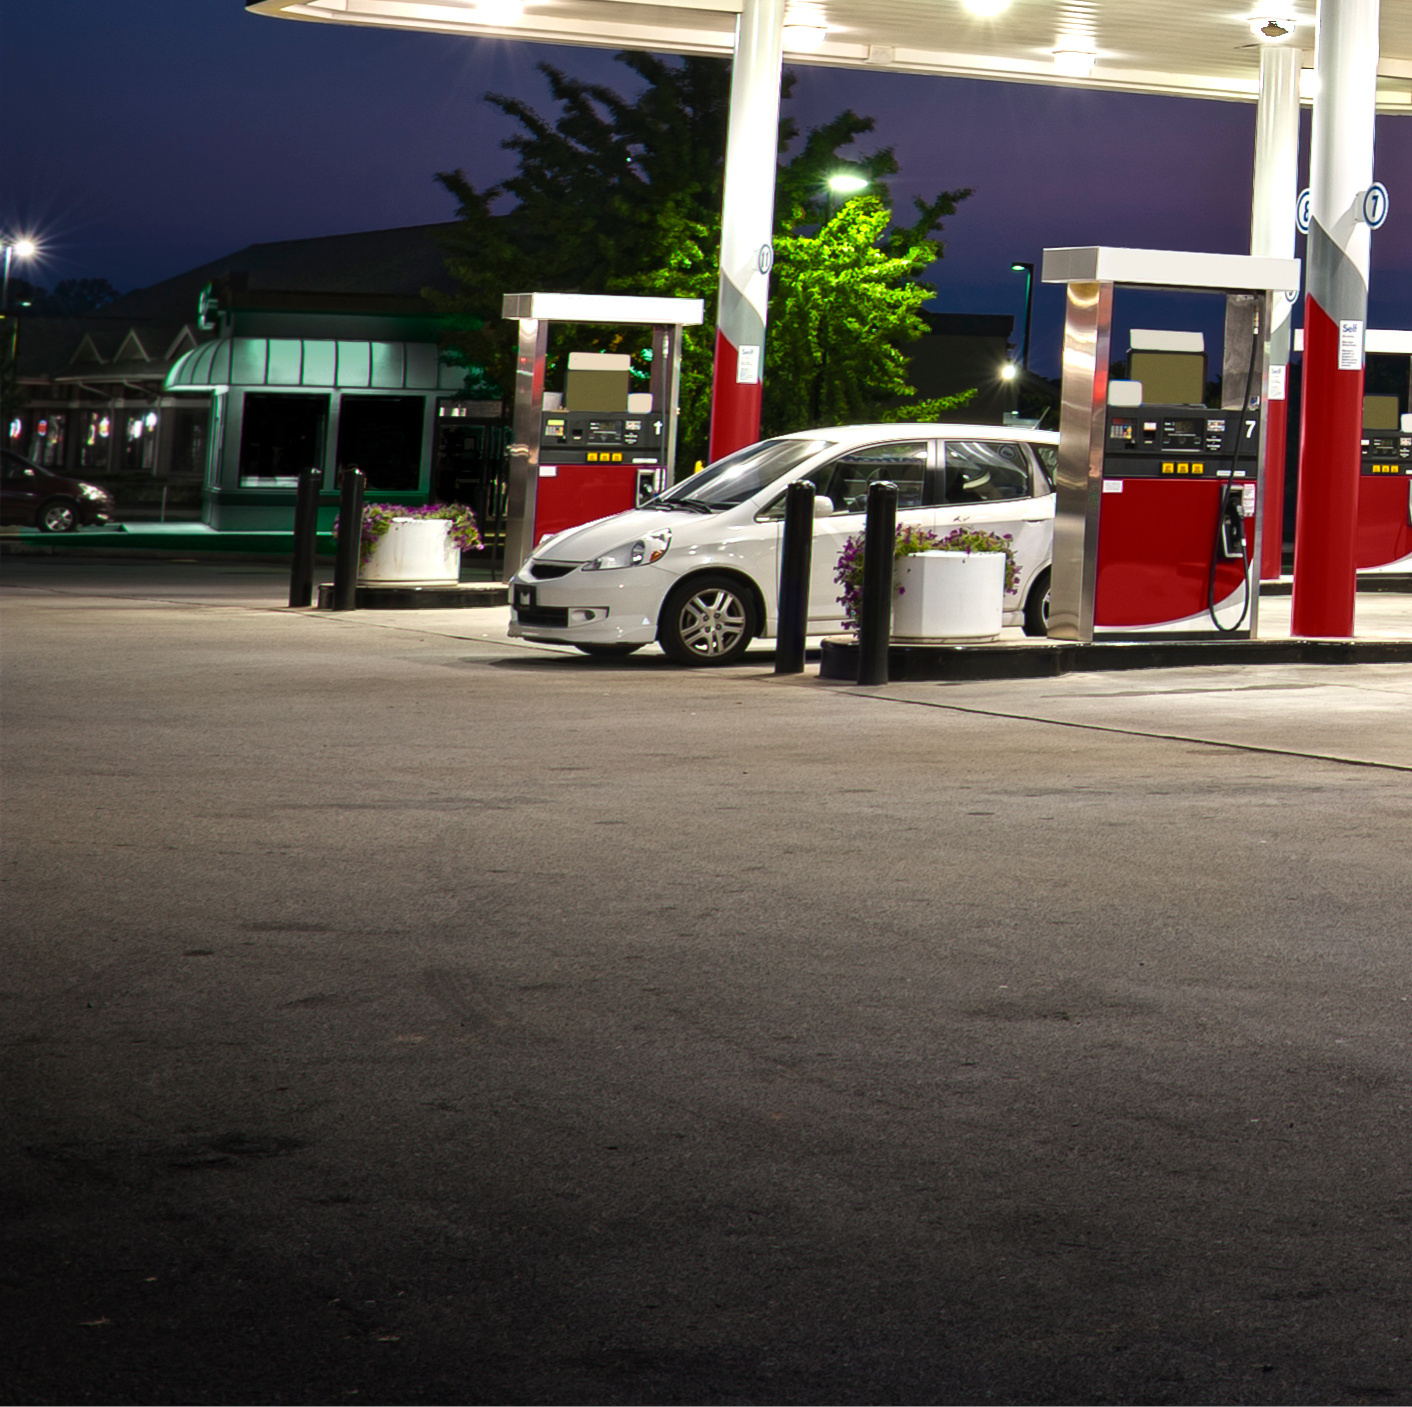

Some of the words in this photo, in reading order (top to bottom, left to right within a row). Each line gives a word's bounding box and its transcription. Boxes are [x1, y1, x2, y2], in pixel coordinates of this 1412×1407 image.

[1371, 195, 1379, 217] 7
[761, 251, 769, 268] 11
[1342, 323, 1358, 333] Self
[1245, 420, 1256, 438] 7
